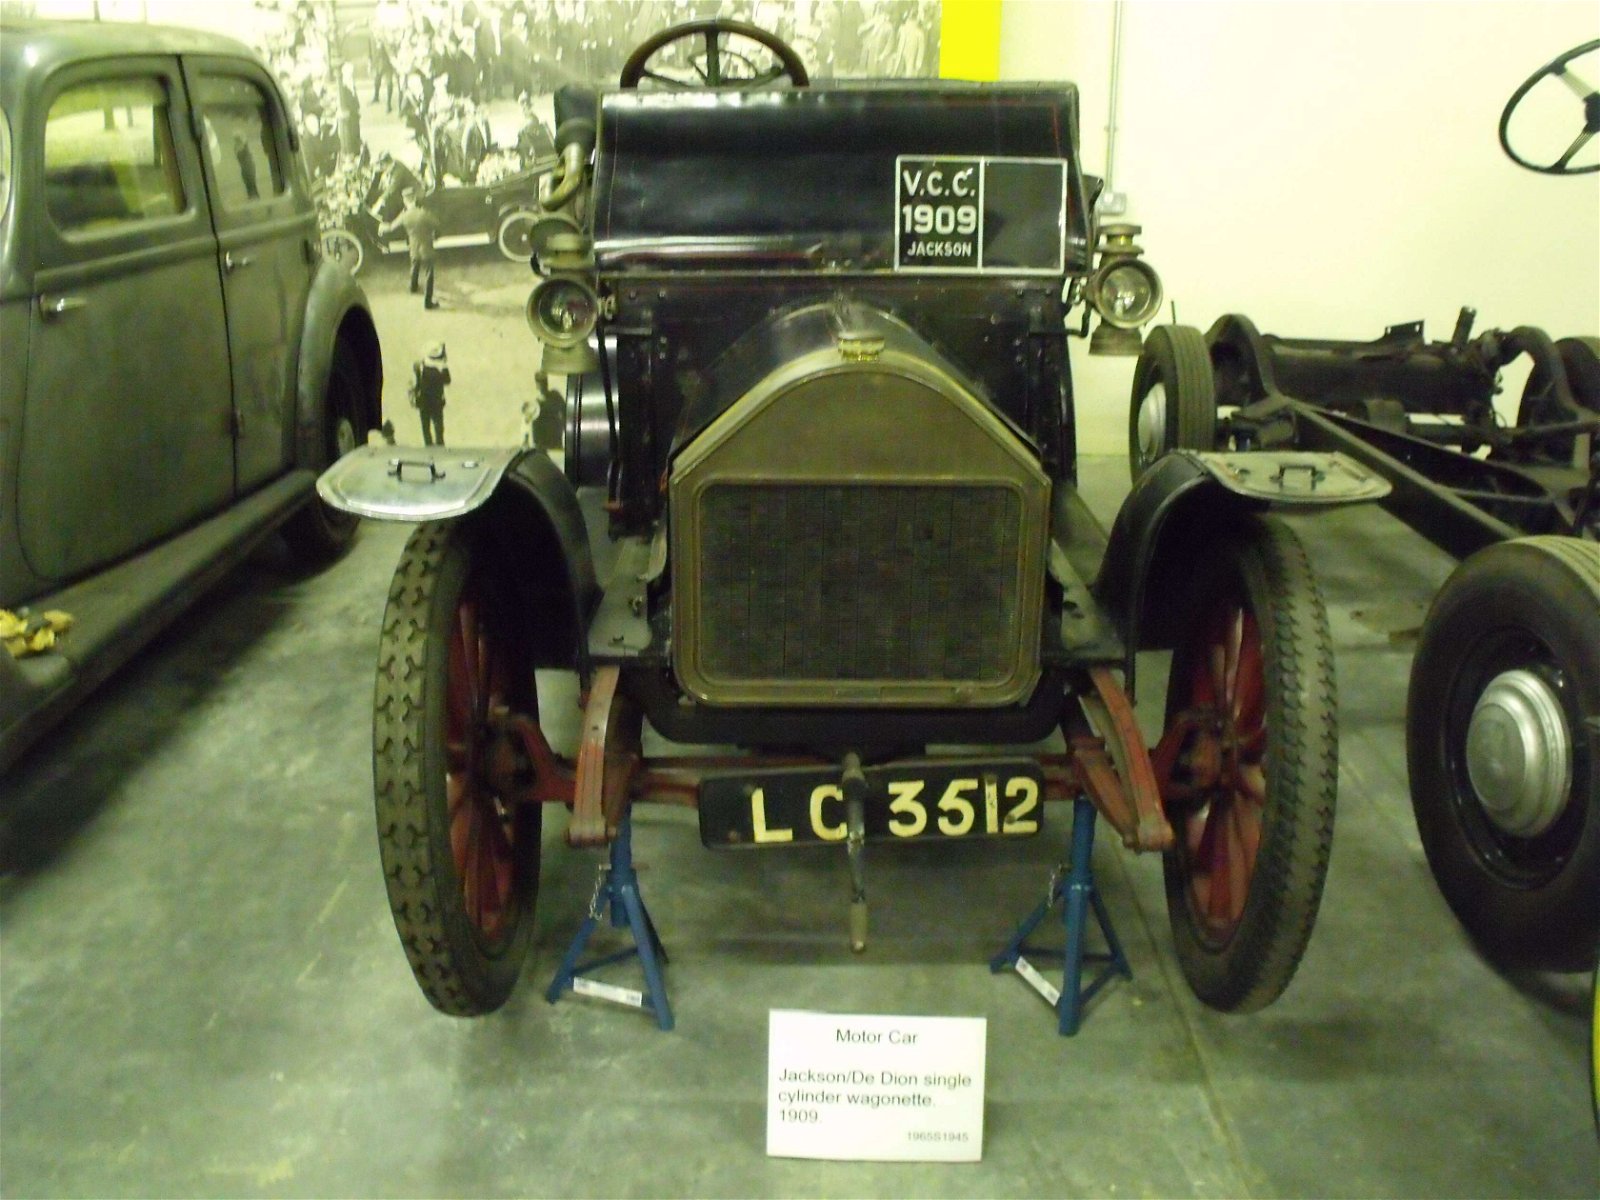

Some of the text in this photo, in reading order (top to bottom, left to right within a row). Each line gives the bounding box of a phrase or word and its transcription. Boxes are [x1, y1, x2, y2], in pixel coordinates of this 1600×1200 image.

[902, 168, 976, 197] V.C.C.
[902, 204, 977, 235] 1909
[907, 241, 972, 257] JACKSON
[888, 776, 1039, 837] 3512
[836, 1029, 918, 1045] Motor Car
[779, 1069, 972, 1090] Jackson/De Dion single
[778, 1089, 936, 1109] cylinder wagonette.
